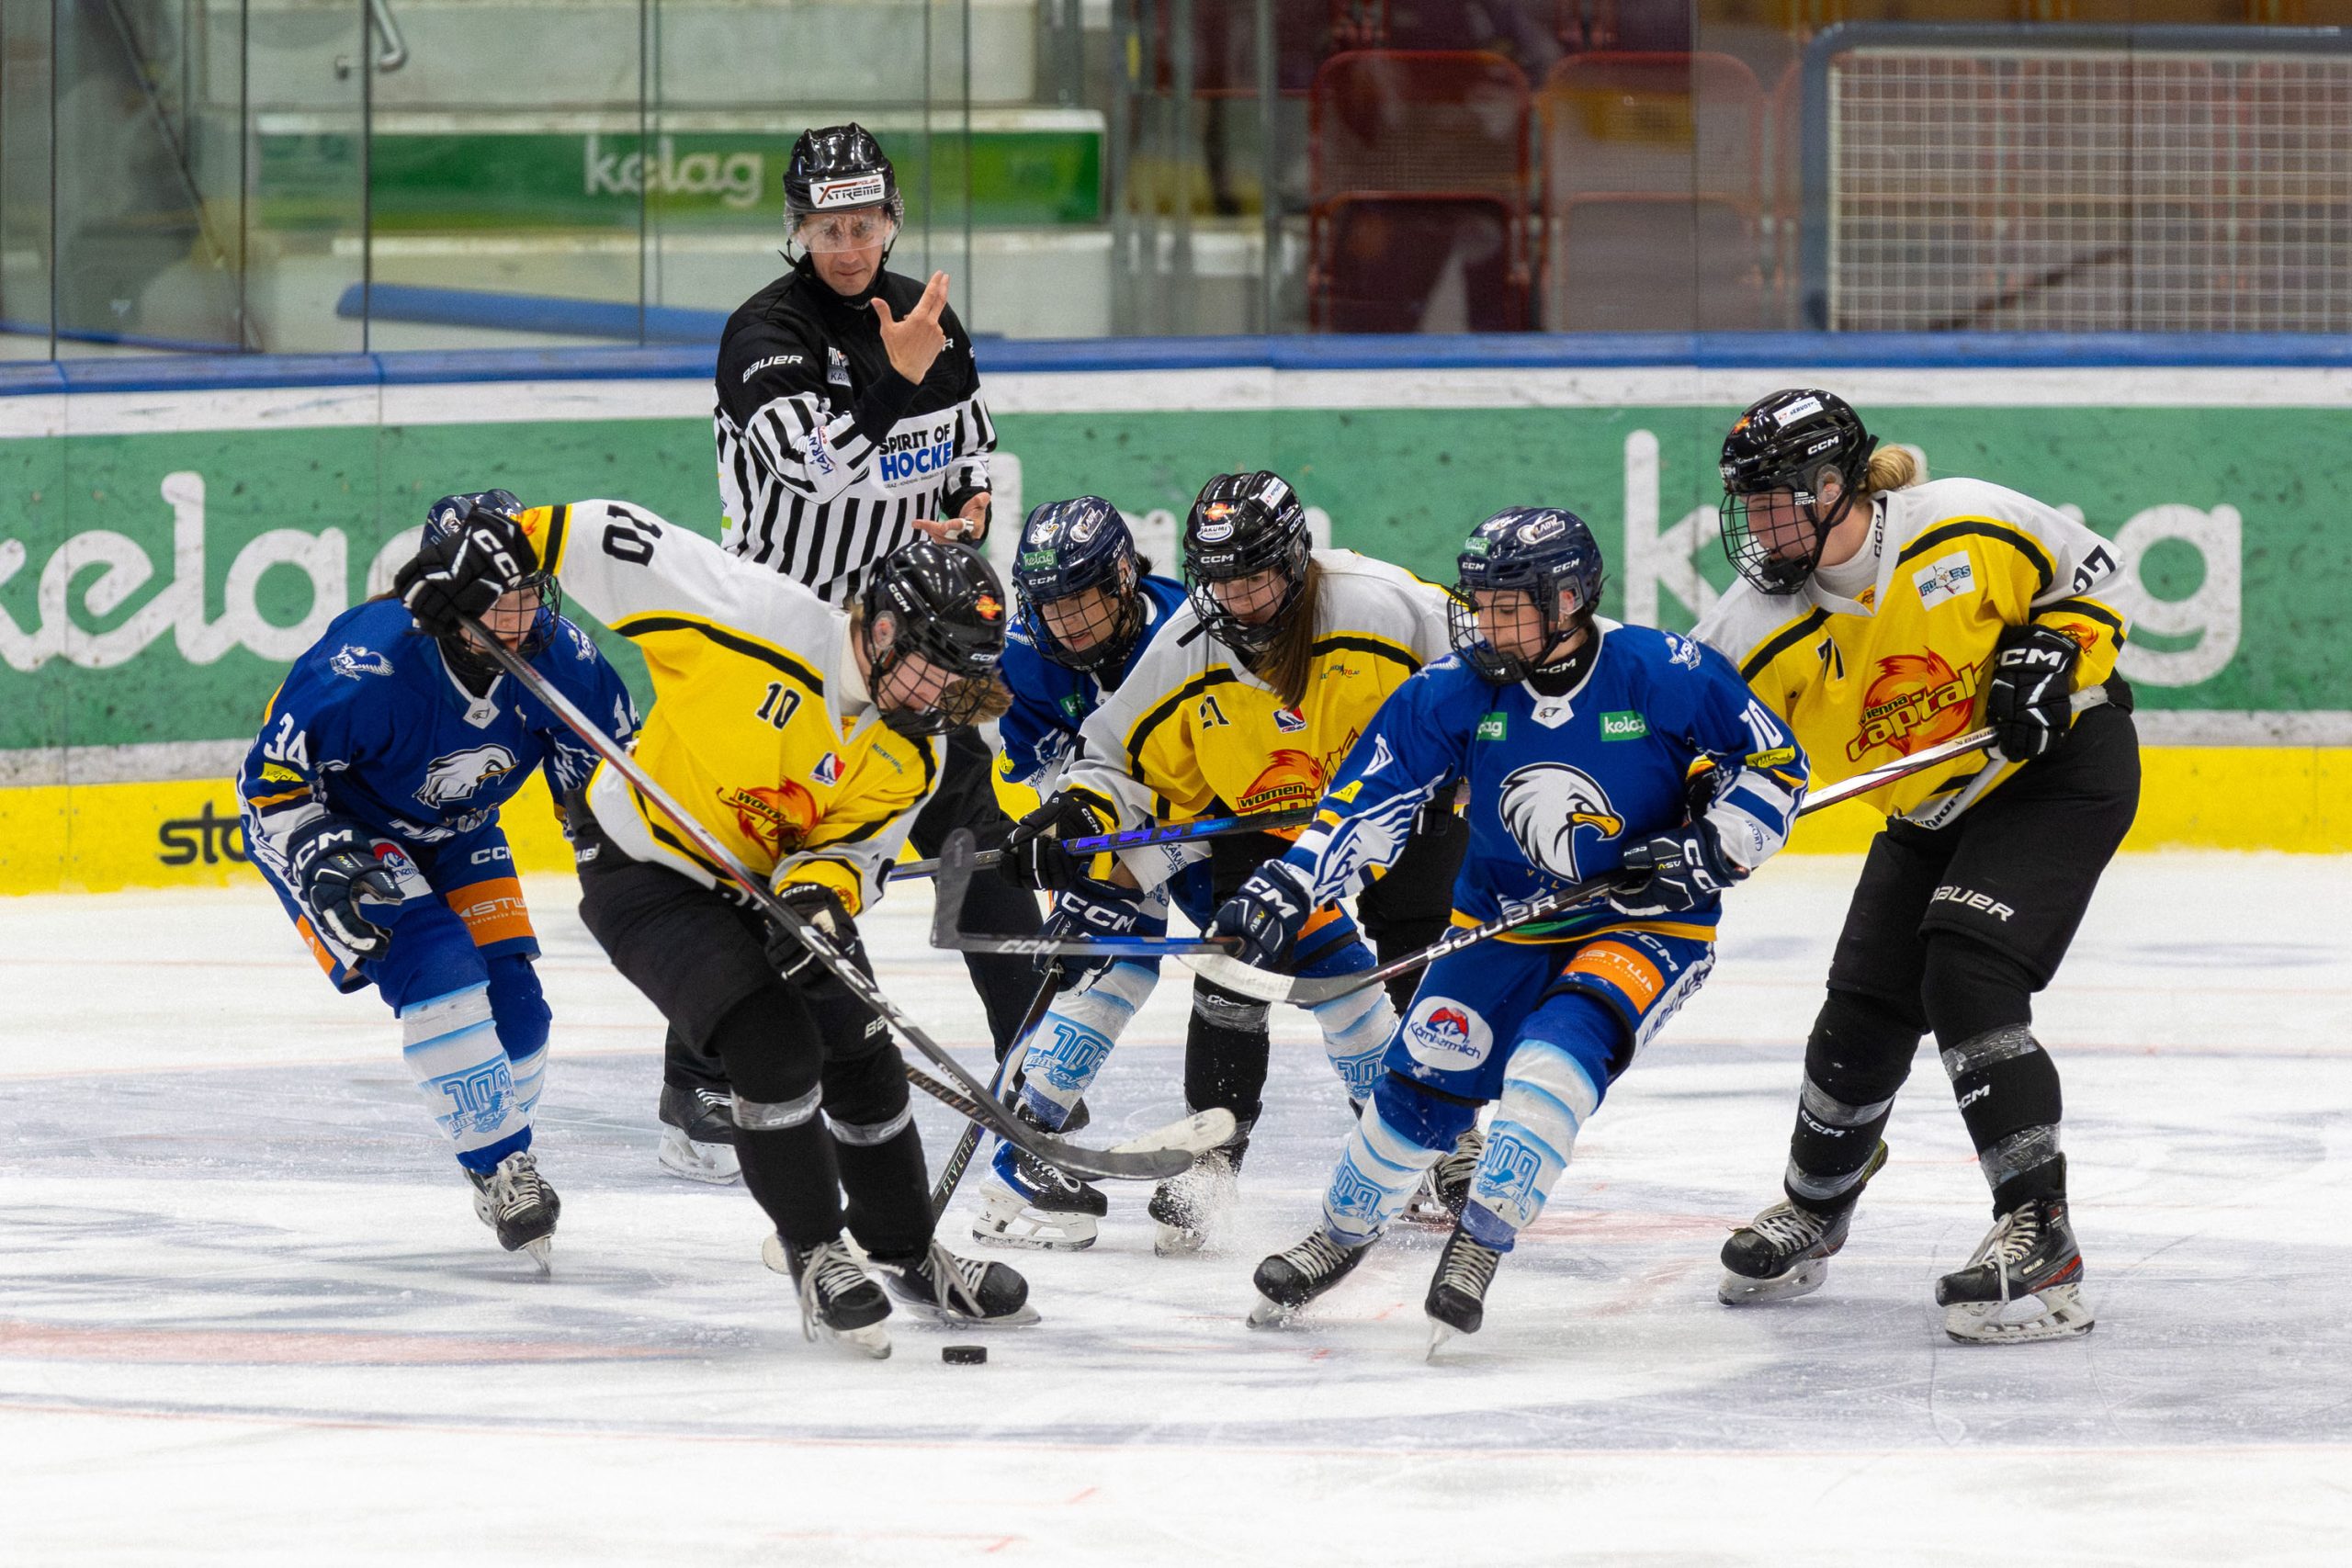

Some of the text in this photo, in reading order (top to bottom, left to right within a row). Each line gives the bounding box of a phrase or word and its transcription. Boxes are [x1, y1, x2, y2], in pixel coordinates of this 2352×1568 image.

[583, 135, 765, 207] kelag
[742, 355, 803, 383] BAUER
[879, 423, 951, 456] SPIRIT OF
[1808, 435, 1839, 456] CCM
[1794, 498, 1816, 506] CCM
[603, 504, 662, 567] 10
[1873, 514, 1883, 558] CCM
[1023, 552, 1055, 567] kelag
[1200, 554, 1234, 564] CCM
[1463, 561, 1485, 570] CCM
[1553, 558, 1579, 574] CCM
[1029, 574, 1057, 586] CCM
[888, 582, 911, 614] CCM
[970, 653, 1000, 662] CCM
[1995, 648, 2064, 668] CM
[756, 682, 802, 729] 10
[263, 713, 310, 771] 34
[1239, 783, 1305, 807] women
[1081, 807, 1102, 835] CCM
[284, 829, 353, 871] CM
[782, 884, 817, 898] CCM
[1245, 876, 1299, 919] CM
[1062, 892, 1137, 933] CCM
[997, 939, 1061, 954] CCM
[1801, 1109, 1846, 1137] CCM
[943, 1134, 977, 1195] FLYLITE
